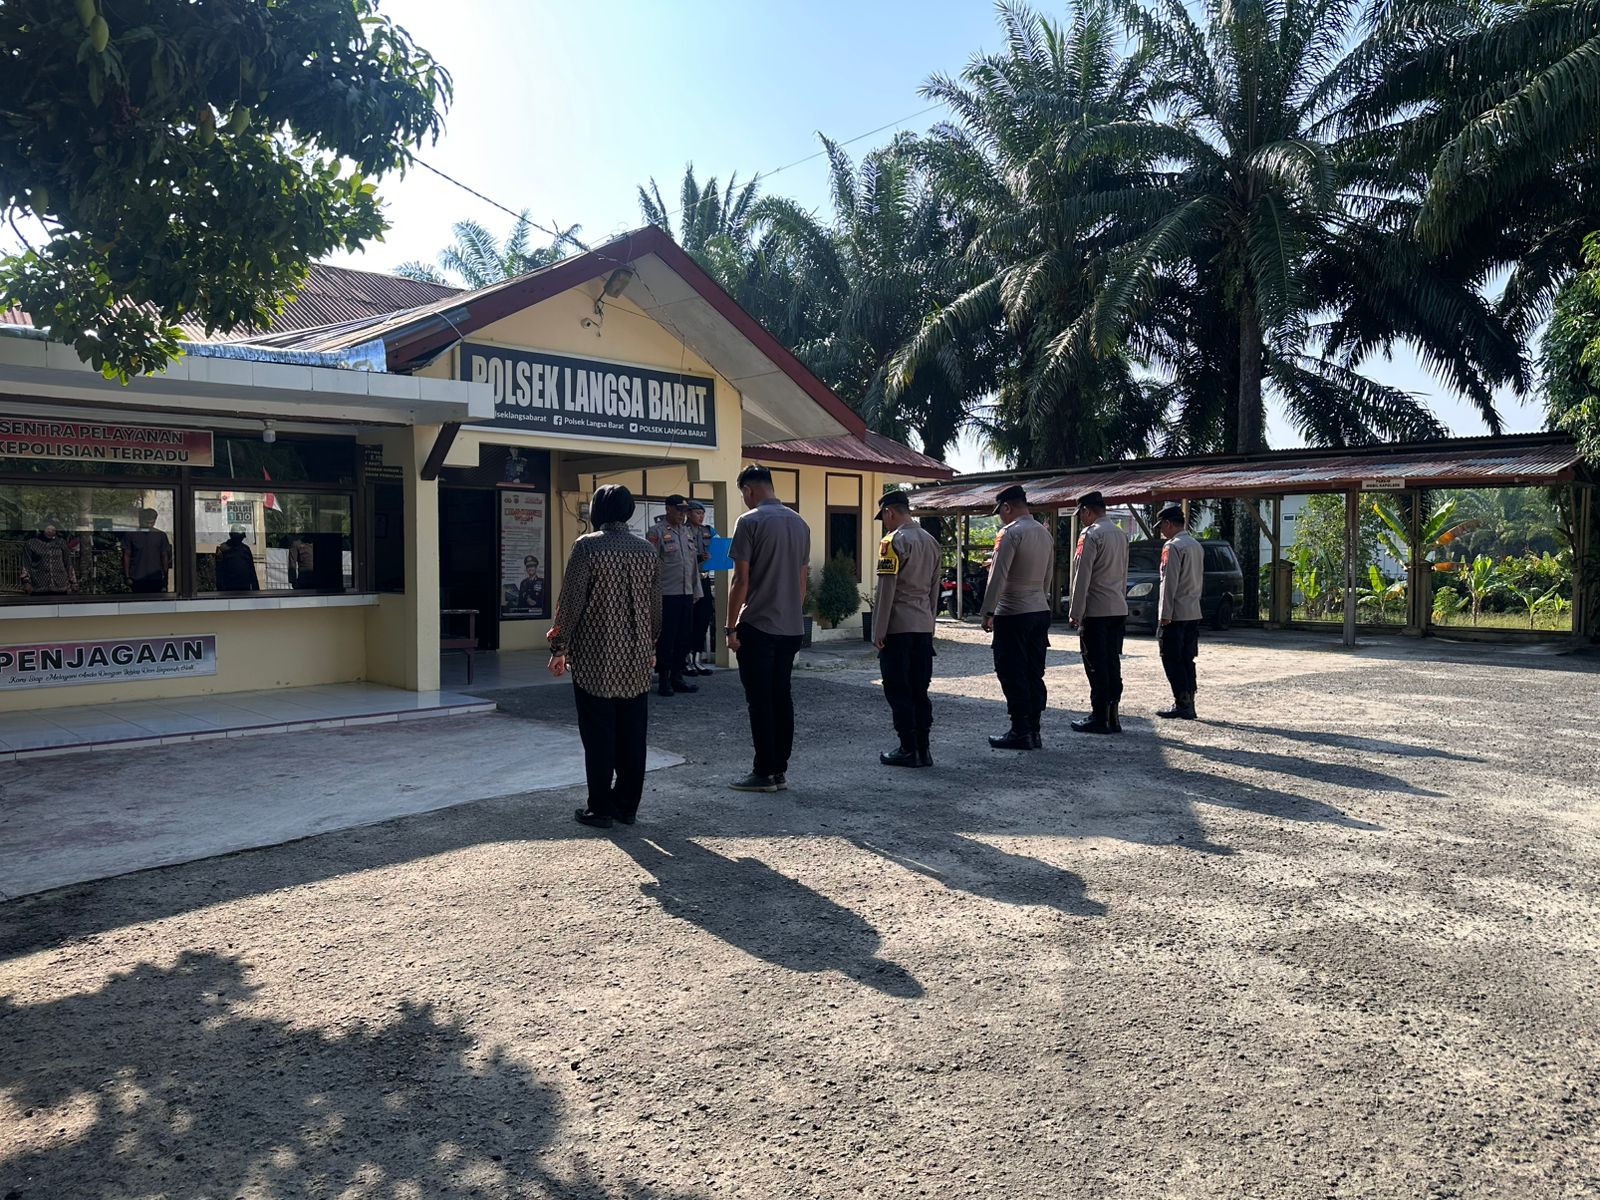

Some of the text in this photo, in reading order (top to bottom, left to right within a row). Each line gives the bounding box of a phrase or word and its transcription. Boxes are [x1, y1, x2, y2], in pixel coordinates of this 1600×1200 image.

[472, 355, 707, 425] POLSEK LANGSA BARAT
[0, 421, 183, 444] SENTRA PELAYANAN
[564, 417, 585, 426] Polsek
[586, 419, 607, 429] Langsa
[608, 421, 624, 430] Barat
[639, 425, 663, 434] POLSEK
[664, 427, 687, 436] LANGSA
[688, 429, 707, 438] BARAT
[110, 446, 189, 462] TERPADU
[0, 641, 203, 673] PENJAGAAN
